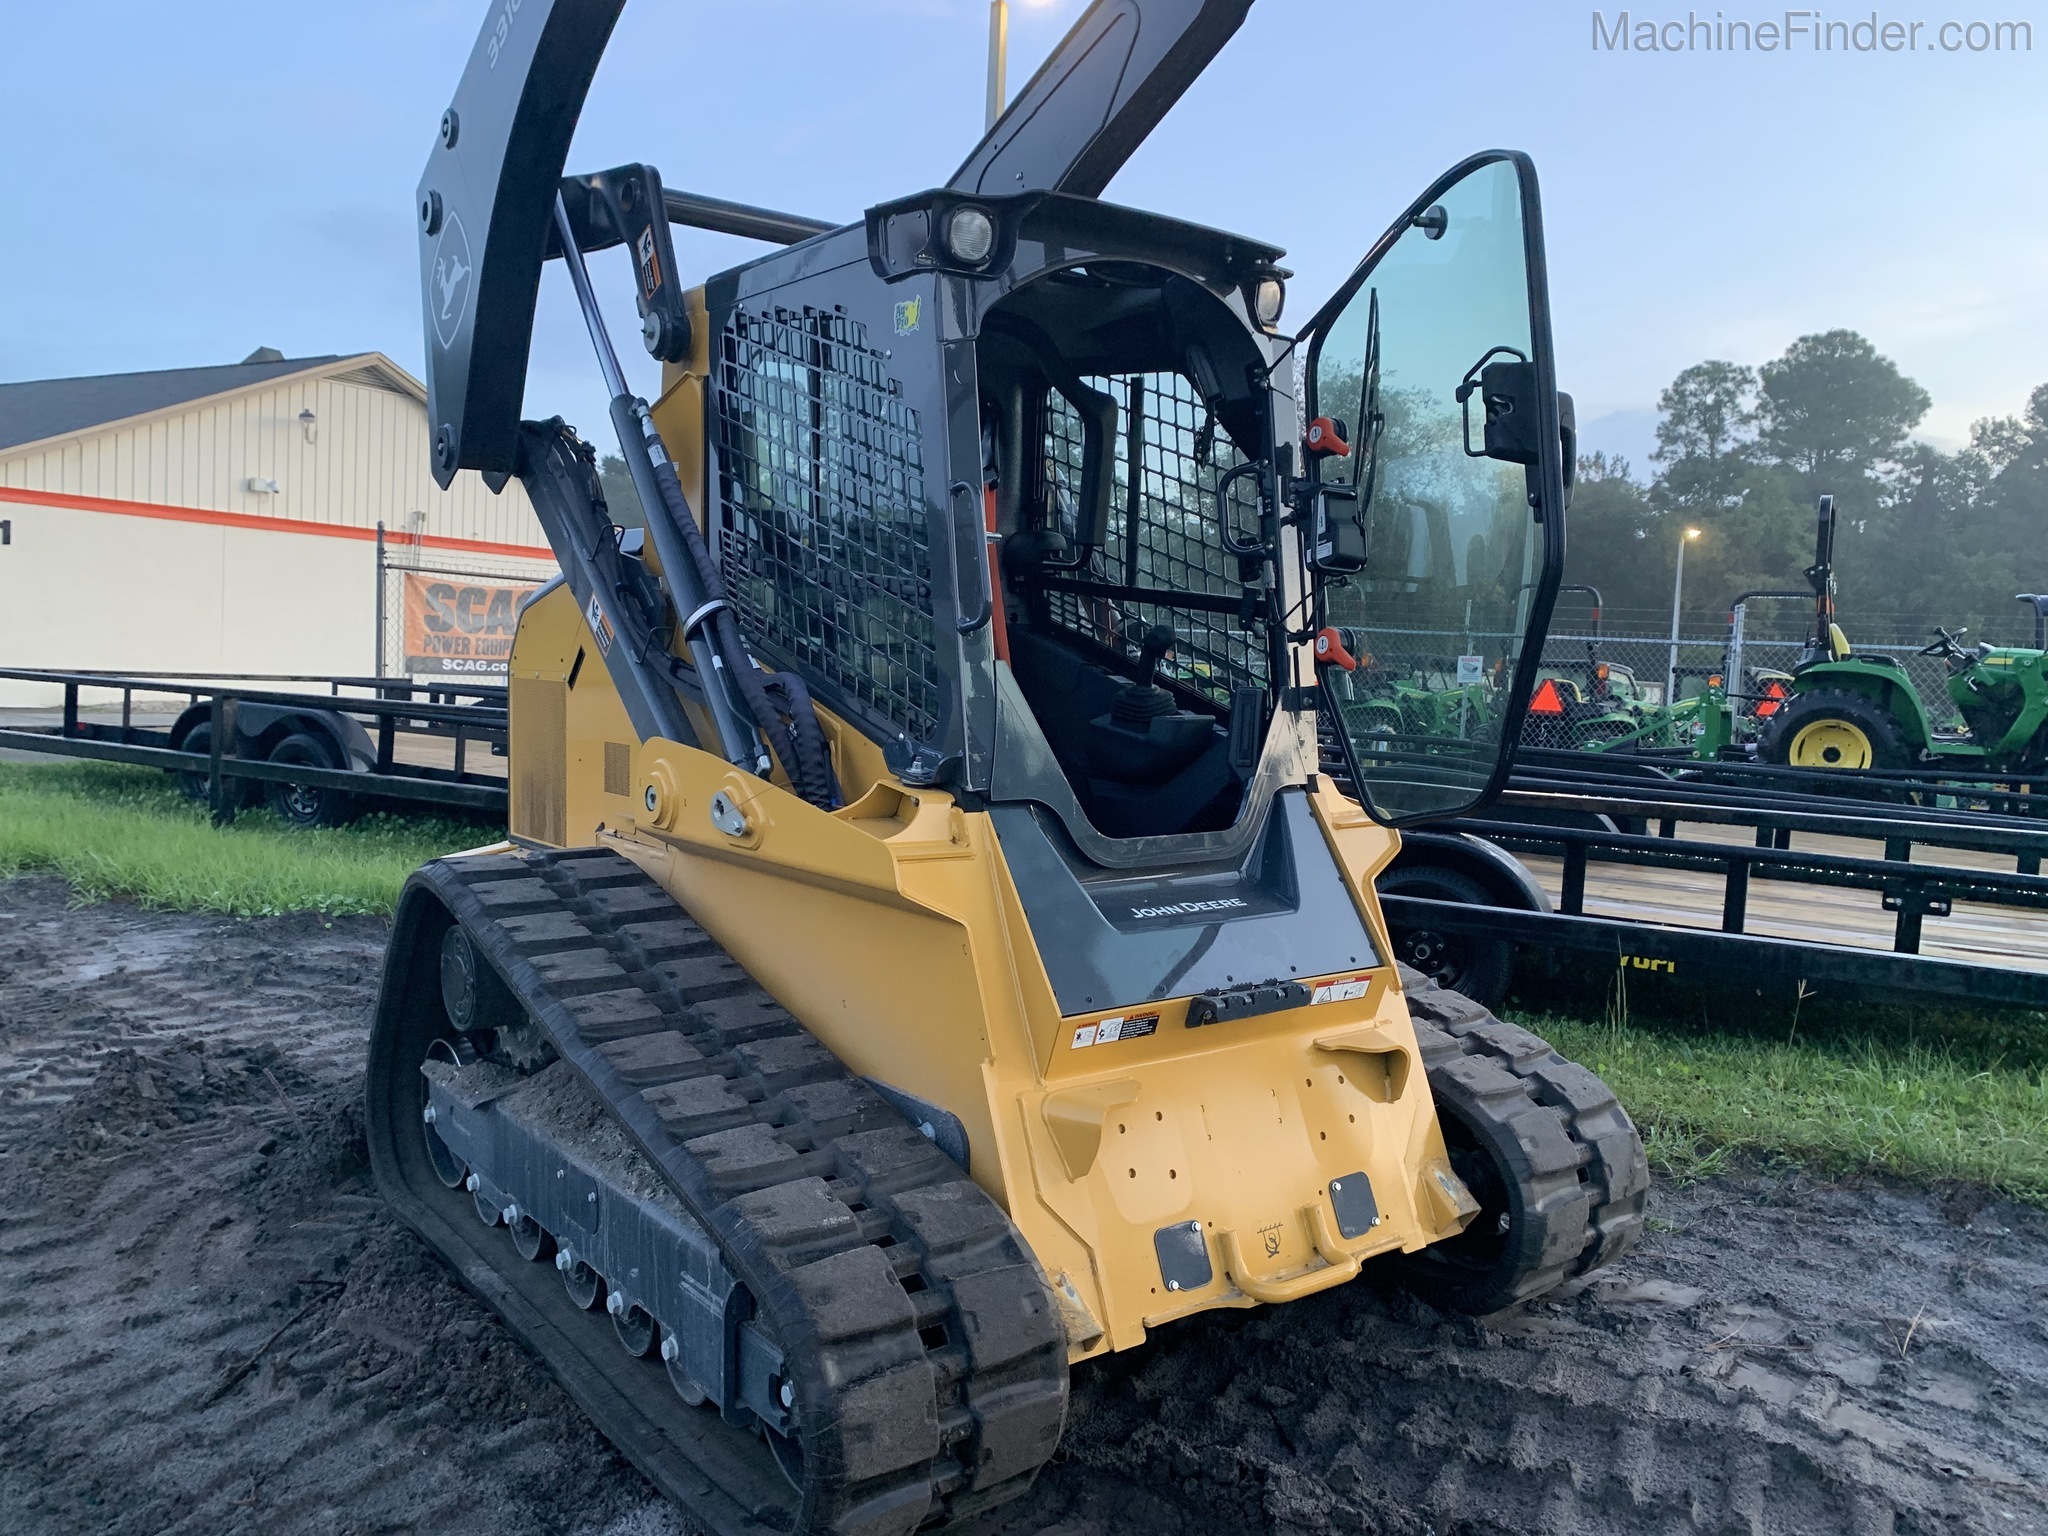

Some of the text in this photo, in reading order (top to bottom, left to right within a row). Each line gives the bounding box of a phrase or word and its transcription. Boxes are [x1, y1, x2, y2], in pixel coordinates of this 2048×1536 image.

[423, 634, 471, 655] POWER
[1131, 898, 1248, 918] JOHN DEERE
